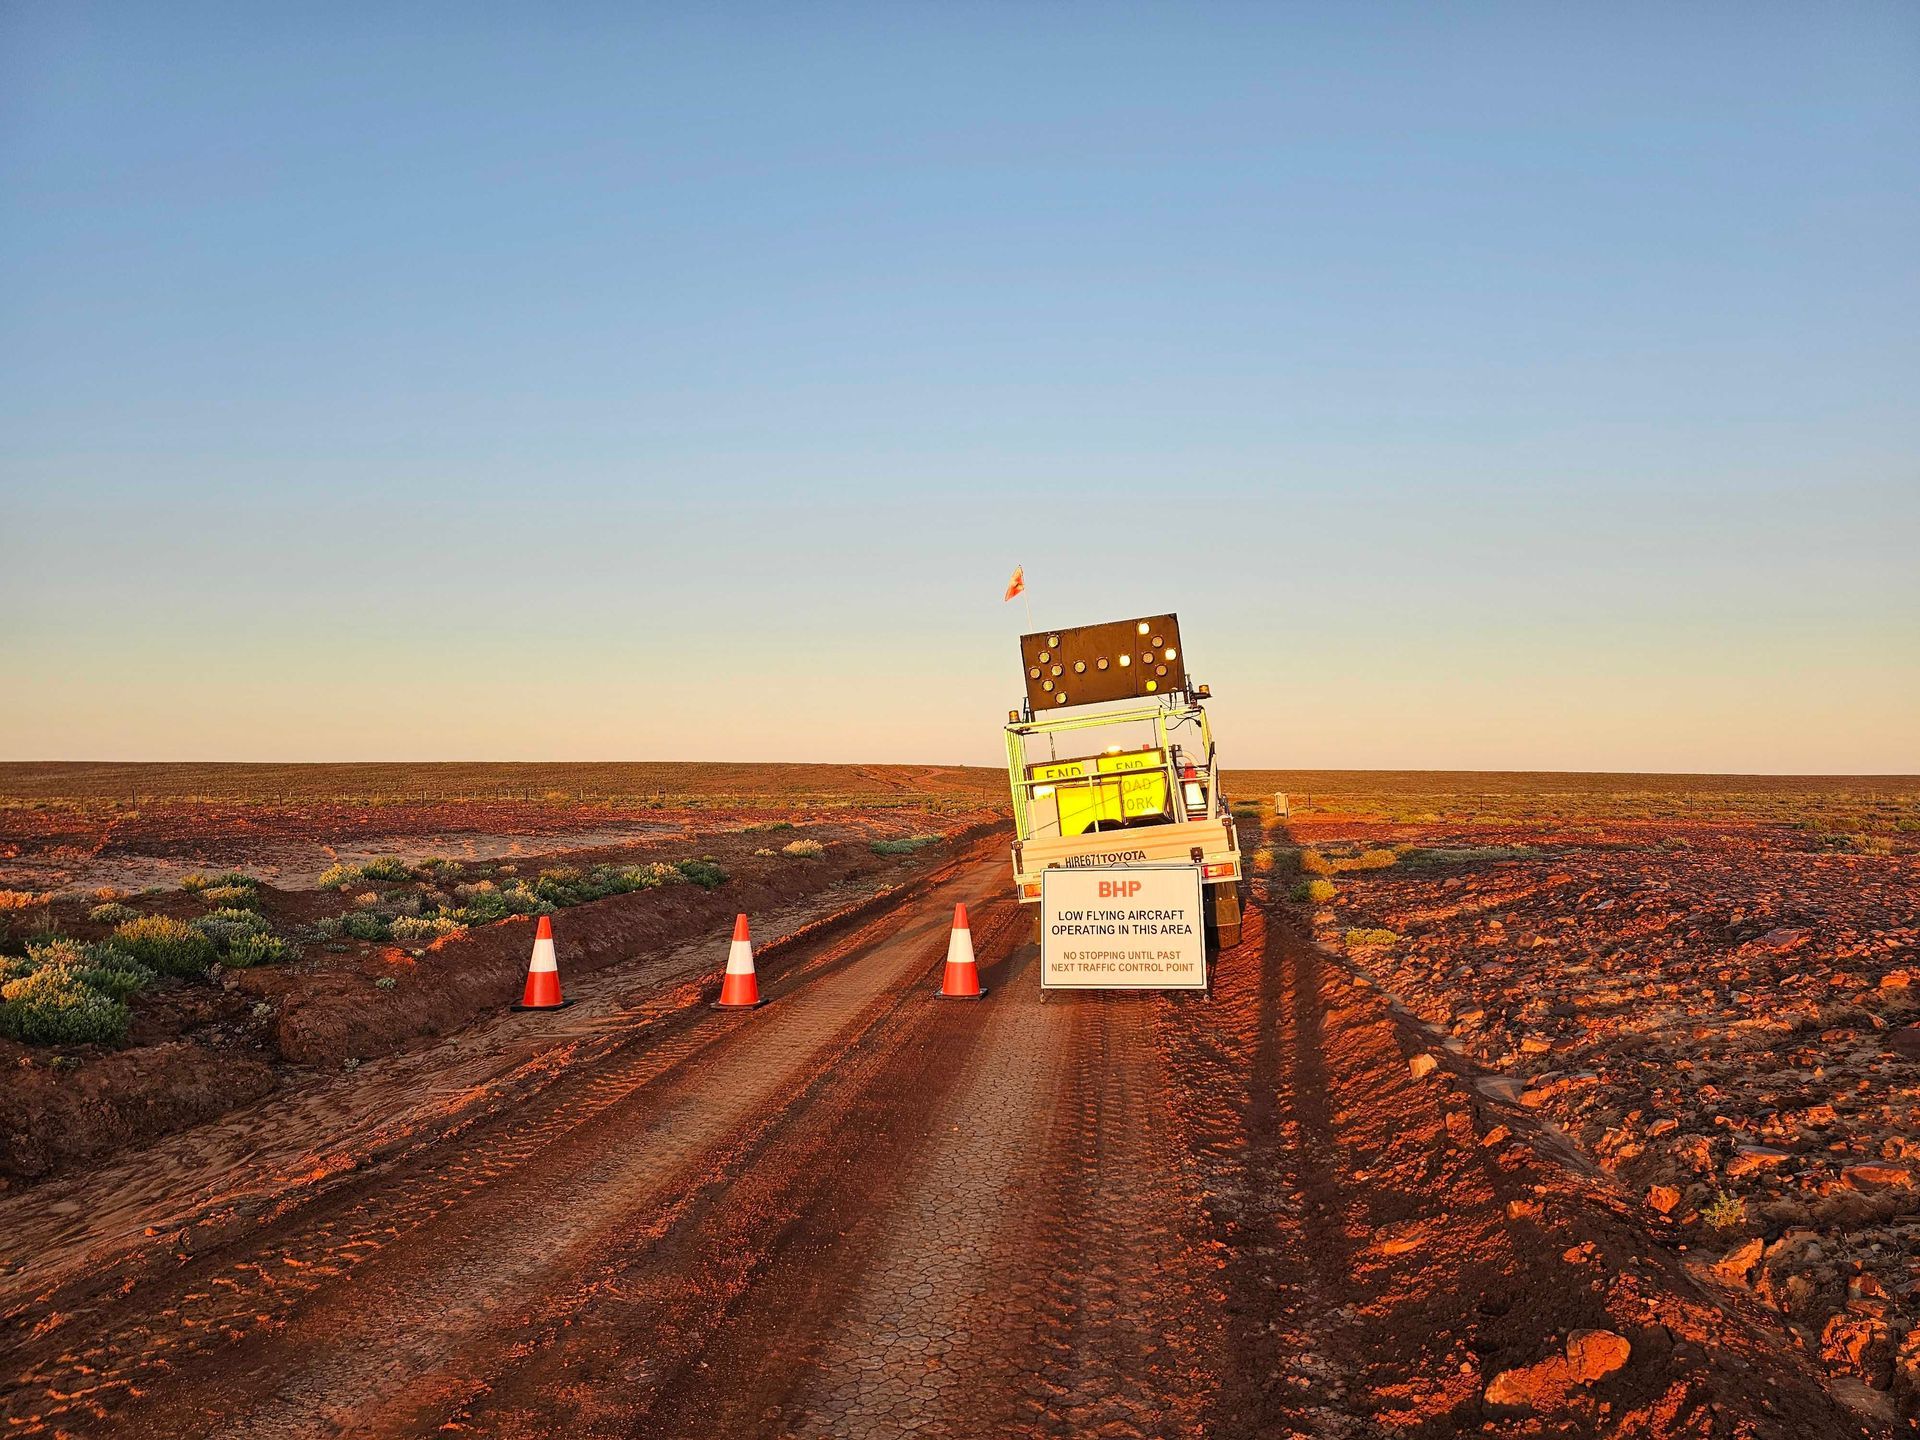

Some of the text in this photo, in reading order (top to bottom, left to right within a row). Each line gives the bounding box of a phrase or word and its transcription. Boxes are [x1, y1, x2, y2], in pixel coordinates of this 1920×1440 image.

[1123, 778, 1151, 792] OAD
[1122, 796, 1154, 811] ORK
[1101, 850, 1147, 864] TOYOTA
[1098, 880, 1142, 897] BHP
[1058, 909, 1185, 921] LOW FLYING AIRCRAFT
[1051, 924, 1193, 935] OPERATING IN THIS AREA
[1063, 950, 1181, 960] NO STOPPING UNTIL PAST
[1051, 962, 1195, 972] NEXT TRAFFIC CONTROL POINT
